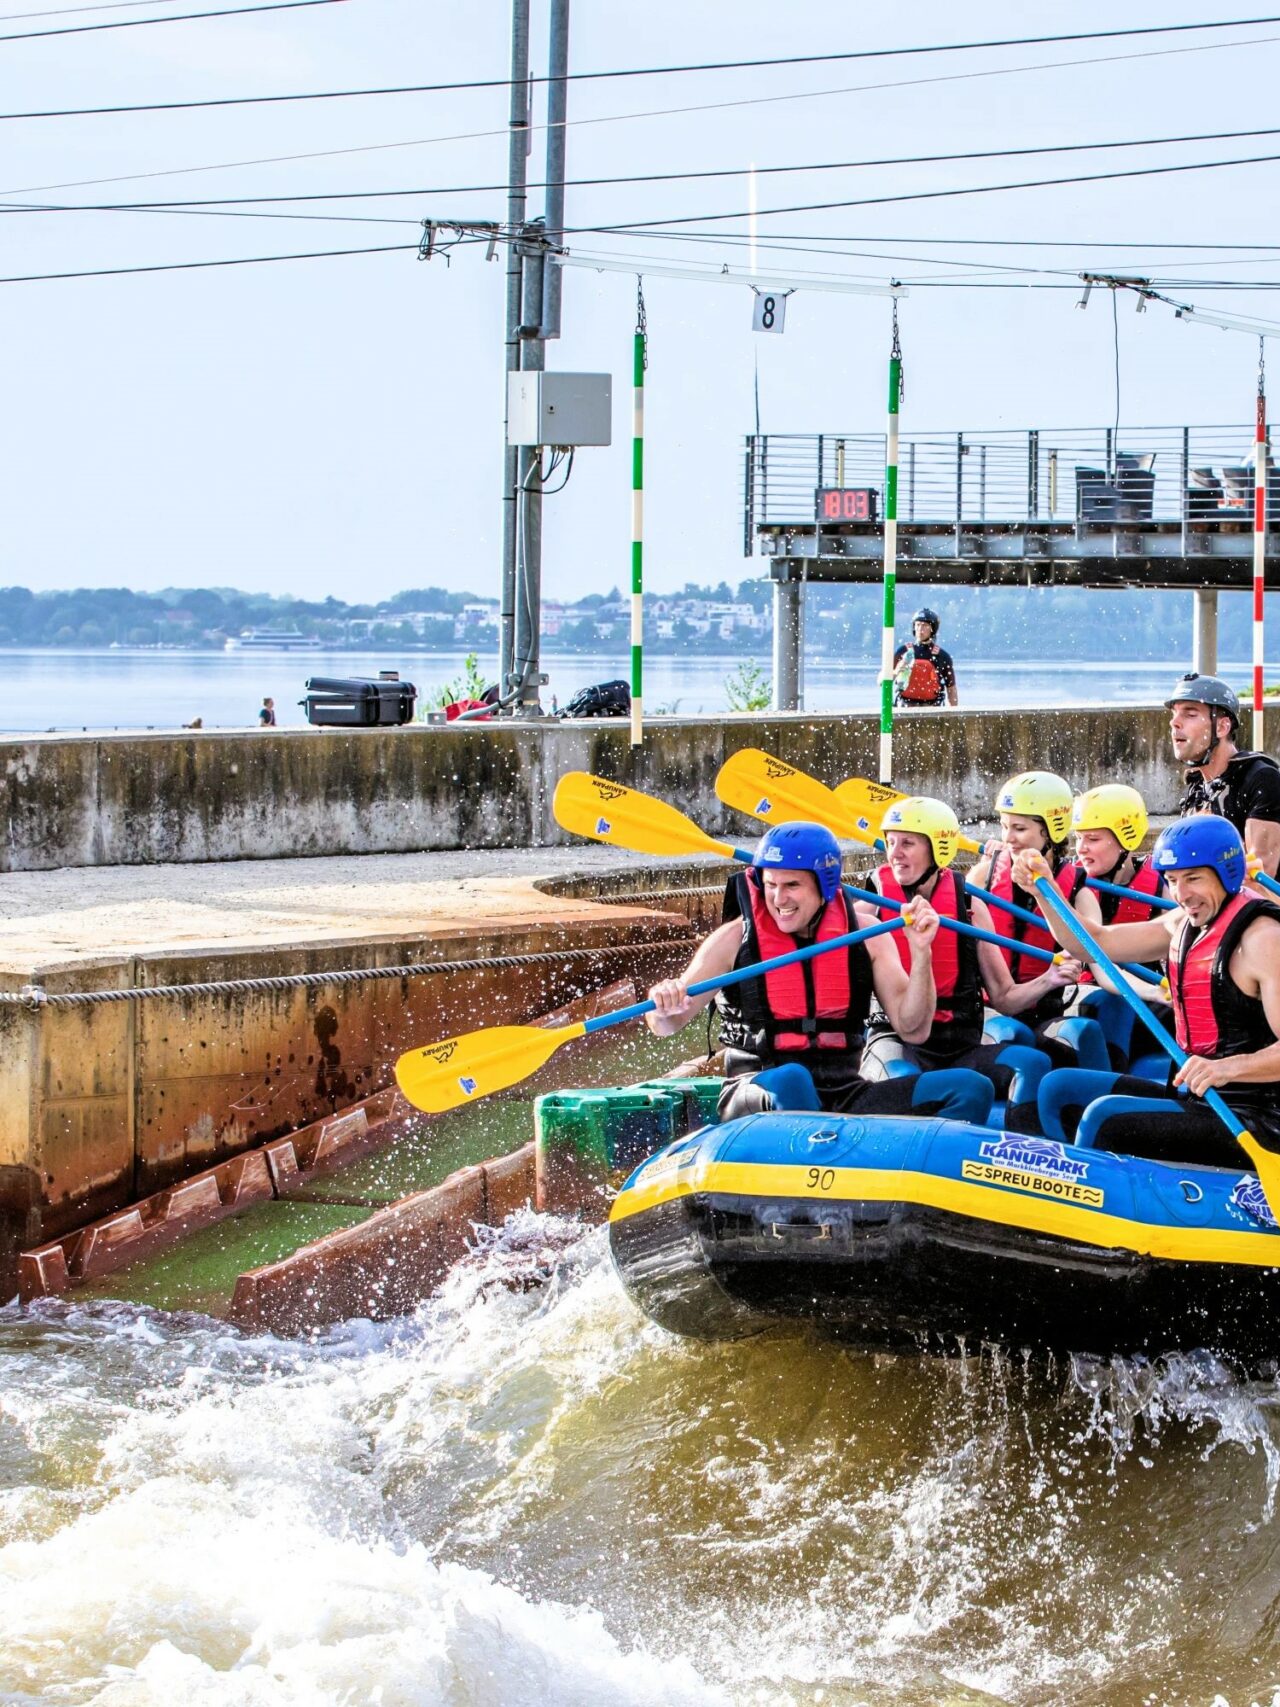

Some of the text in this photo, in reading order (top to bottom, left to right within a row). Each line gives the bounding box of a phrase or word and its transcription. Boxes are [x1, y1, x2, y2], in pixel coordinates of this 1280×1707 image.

[762, 296, 775, 329] 8
[982, 1143, 1087, 1177] KANUPARK
[806, 1167, 836, 1191] 90
[984, 1167, 1082, 1199] SPREU BOOTE
